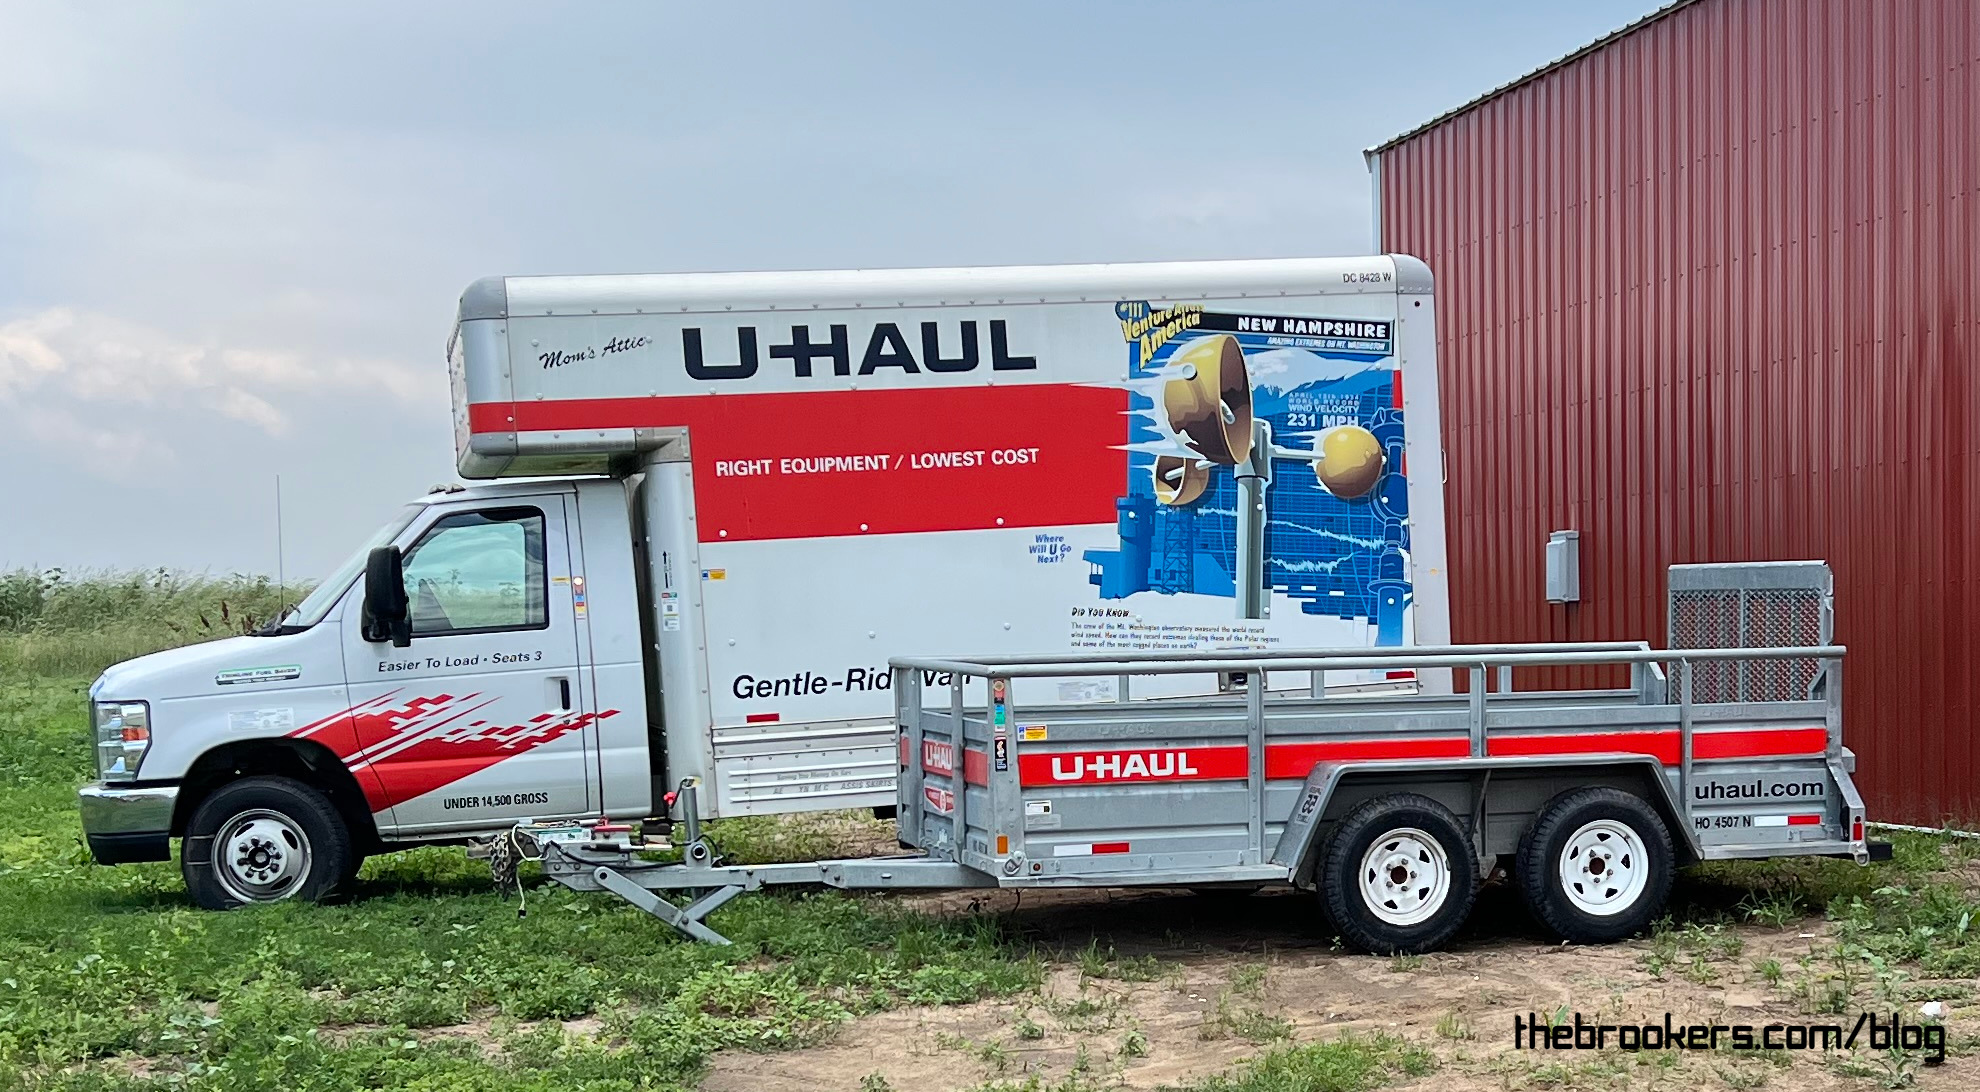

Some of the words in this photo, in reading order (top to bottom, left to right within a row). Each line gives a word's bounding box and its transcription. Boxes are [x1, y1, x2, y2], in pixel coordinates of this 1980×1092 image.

[1343, 273, 1357, 283] DC
[1382, 271, 1392, 282] W
[1120, 308, 1173, 342] Venture
[1238, 317, 1276, 332] NEW
[1284, 319, 1387, 338] HAMPSHIRE
[682, 320, 1037, 380] U-HAUL
[1140, 313, 1201, 369] America
[539, 346, 596, 369] Mom's
[602, 336, 645, 357] Attic
[1288, 404, 1312, 412] WIND
[1315, 404, 1359, 413] VELOCITY
[1287, 413, 1316, 427] 231
[1322, 414, 1359, 427] MPH
[715, 459, 773, 477] RIGHT
[780, 454, 890, 474] EQUIPMENT
[894, 454, 904, 471] /
[911, 451, 985, 470] LOWEST
[991, 448, 1040, 465] COST
[1035, 534, 1064, 543] Where
[1029, 545, 1047, 554] Will
[1050, 544, 1057, 555] U
[1060, 544, 1072, 552] Go
[1037, 553, 1065, 563] Next?
[378, 660, 421, 673] Easier
[425, 657, 441, 669] To
[445, 654, 479, 667] Load
[492, 652, 530, 664] Seats
[534, 651, 543, 661] 3
[733, 666, 893, 699] Gentle-Rid
[925, 743, 953, 771] U-HAU
[1052, 752, 1198, 781] U-HAUL
[1695, 780, 1823, 799] uhaul.com
[443, 796, 479, 809] UNDER
[481, 795, 512, 808] 14,500
[514, 792, 548, 804] GROSS
[1695, 817, 1710, 829] HO
[1715, 816, 1739, 829] 4507
[1743, 816, 1751, 828] N
